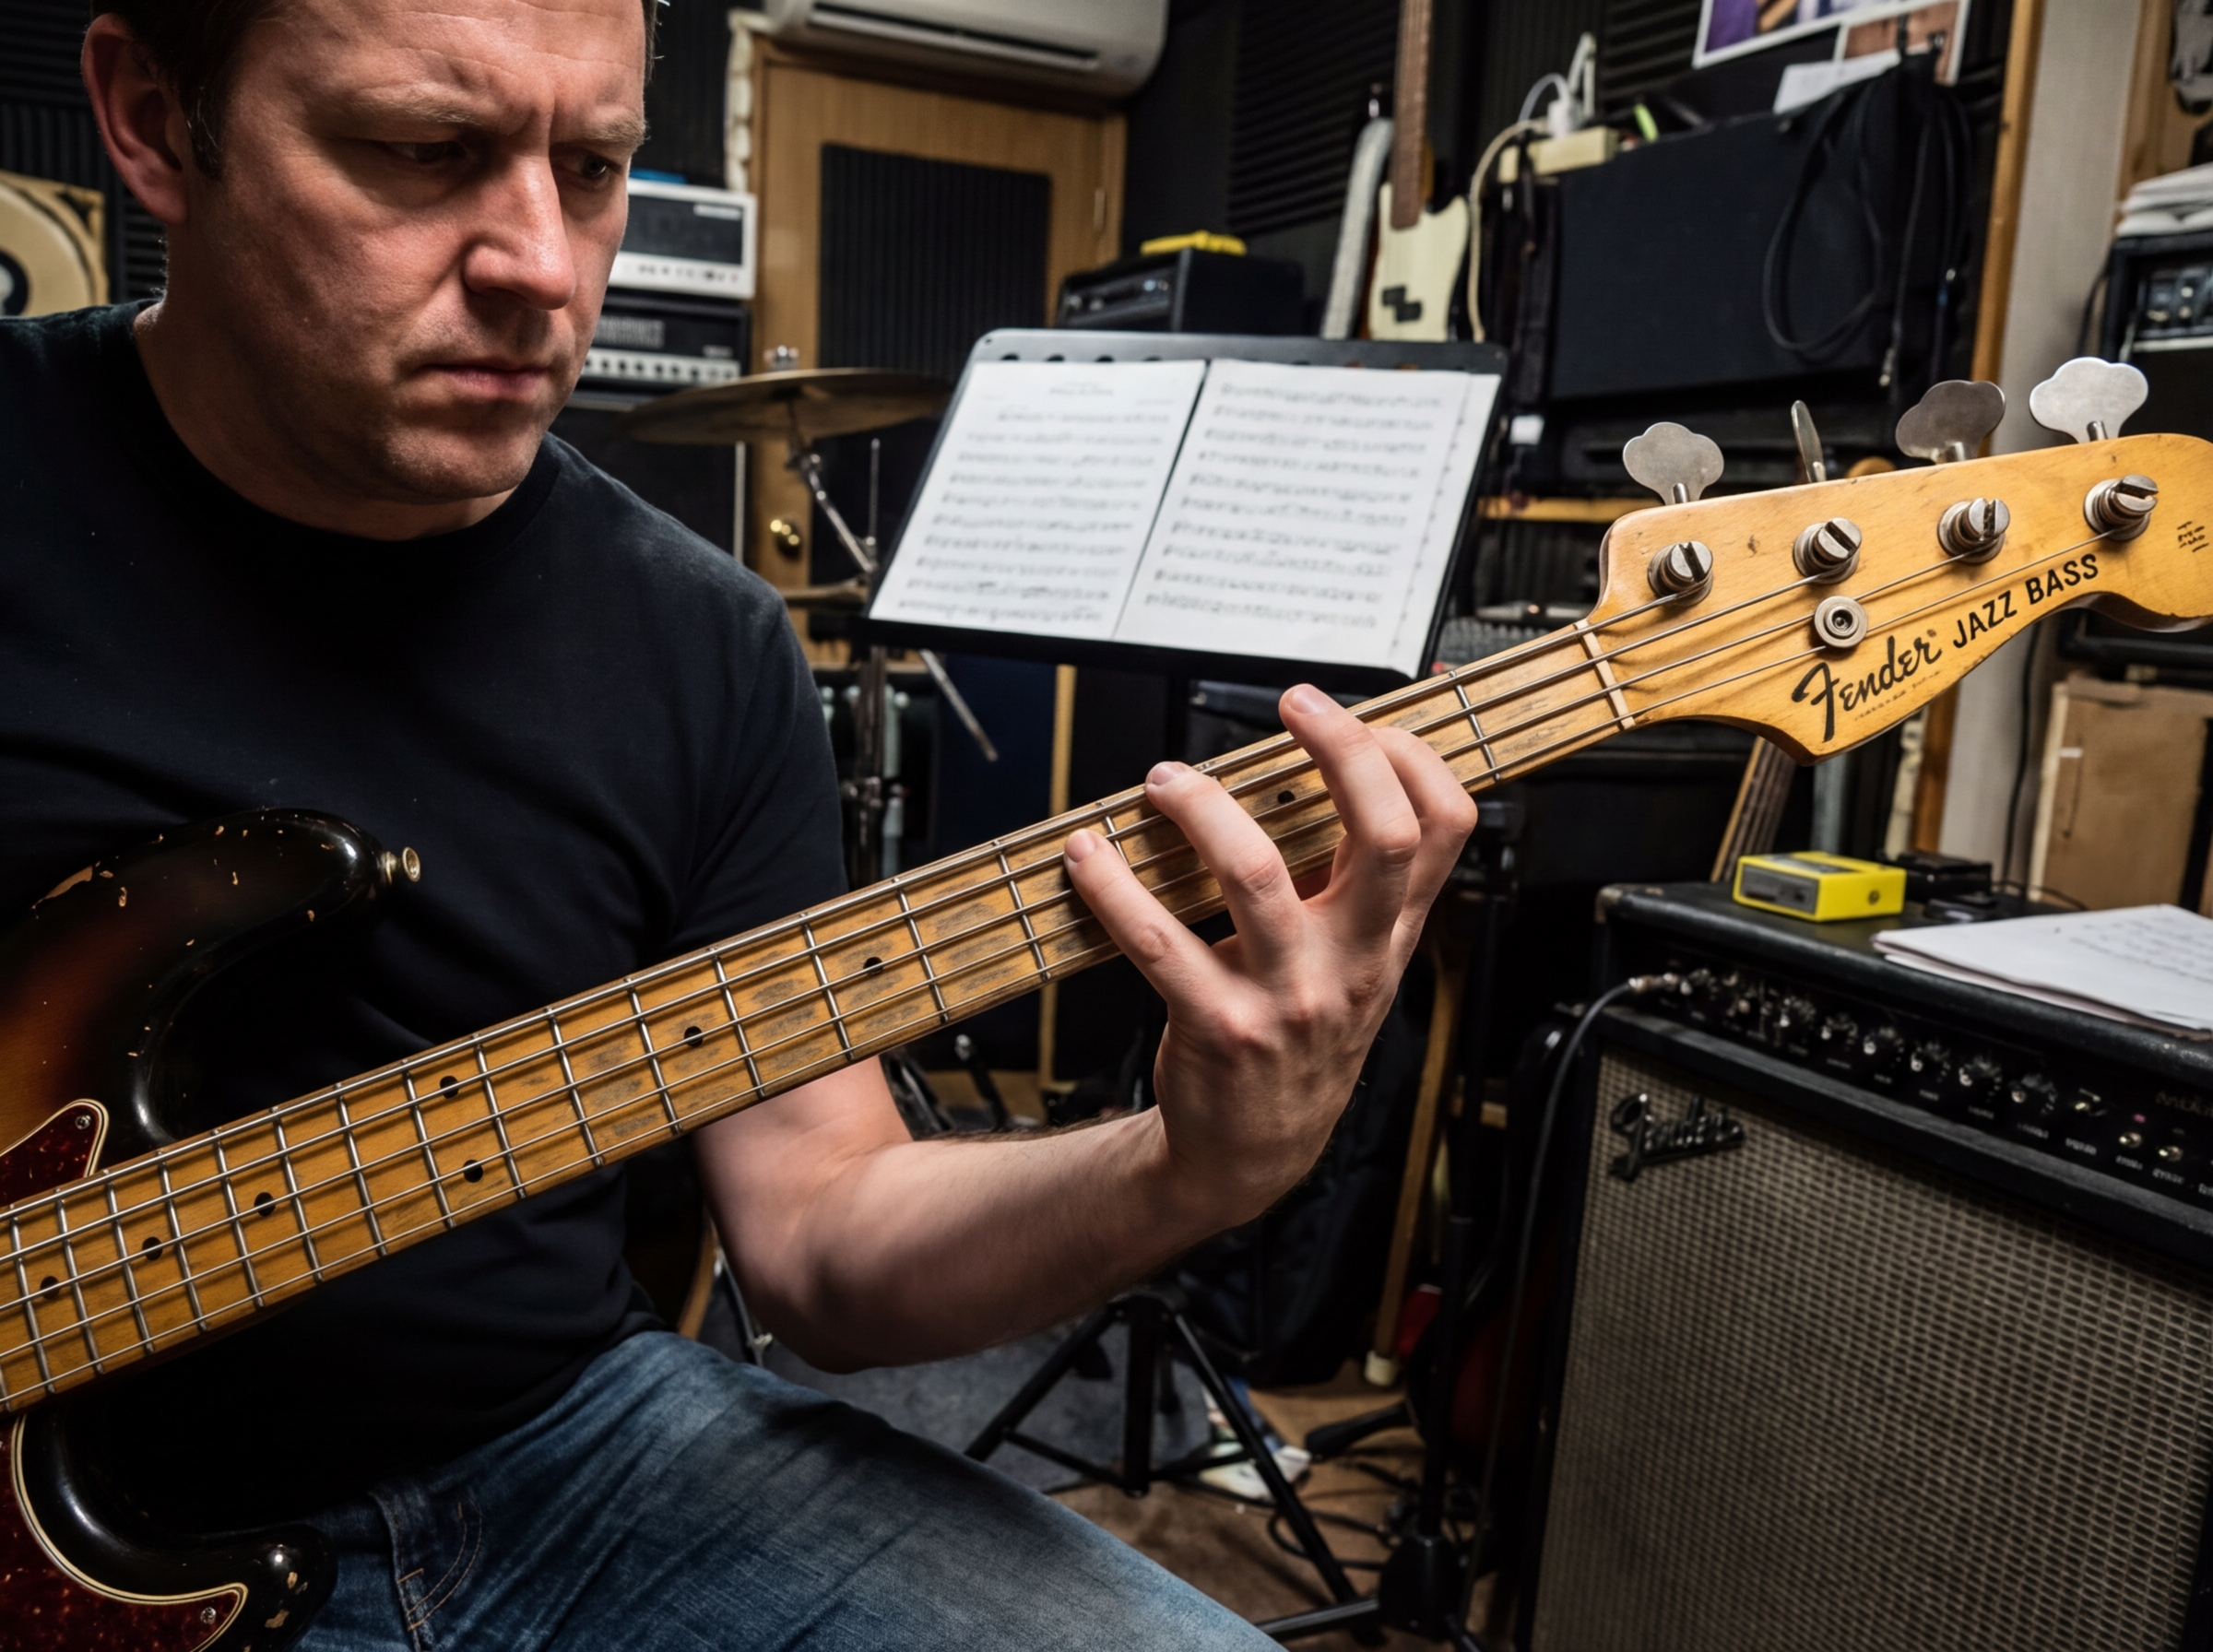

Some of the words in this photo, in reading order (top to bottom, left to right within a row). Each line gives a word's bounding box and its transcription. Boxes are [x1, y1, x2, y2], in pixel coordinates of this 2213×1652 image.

[1792, 635, 1943, 744] Fender
[1953, 590, 2018, 648] JAZZ
[2025, 553, 2099, 605] BASS
